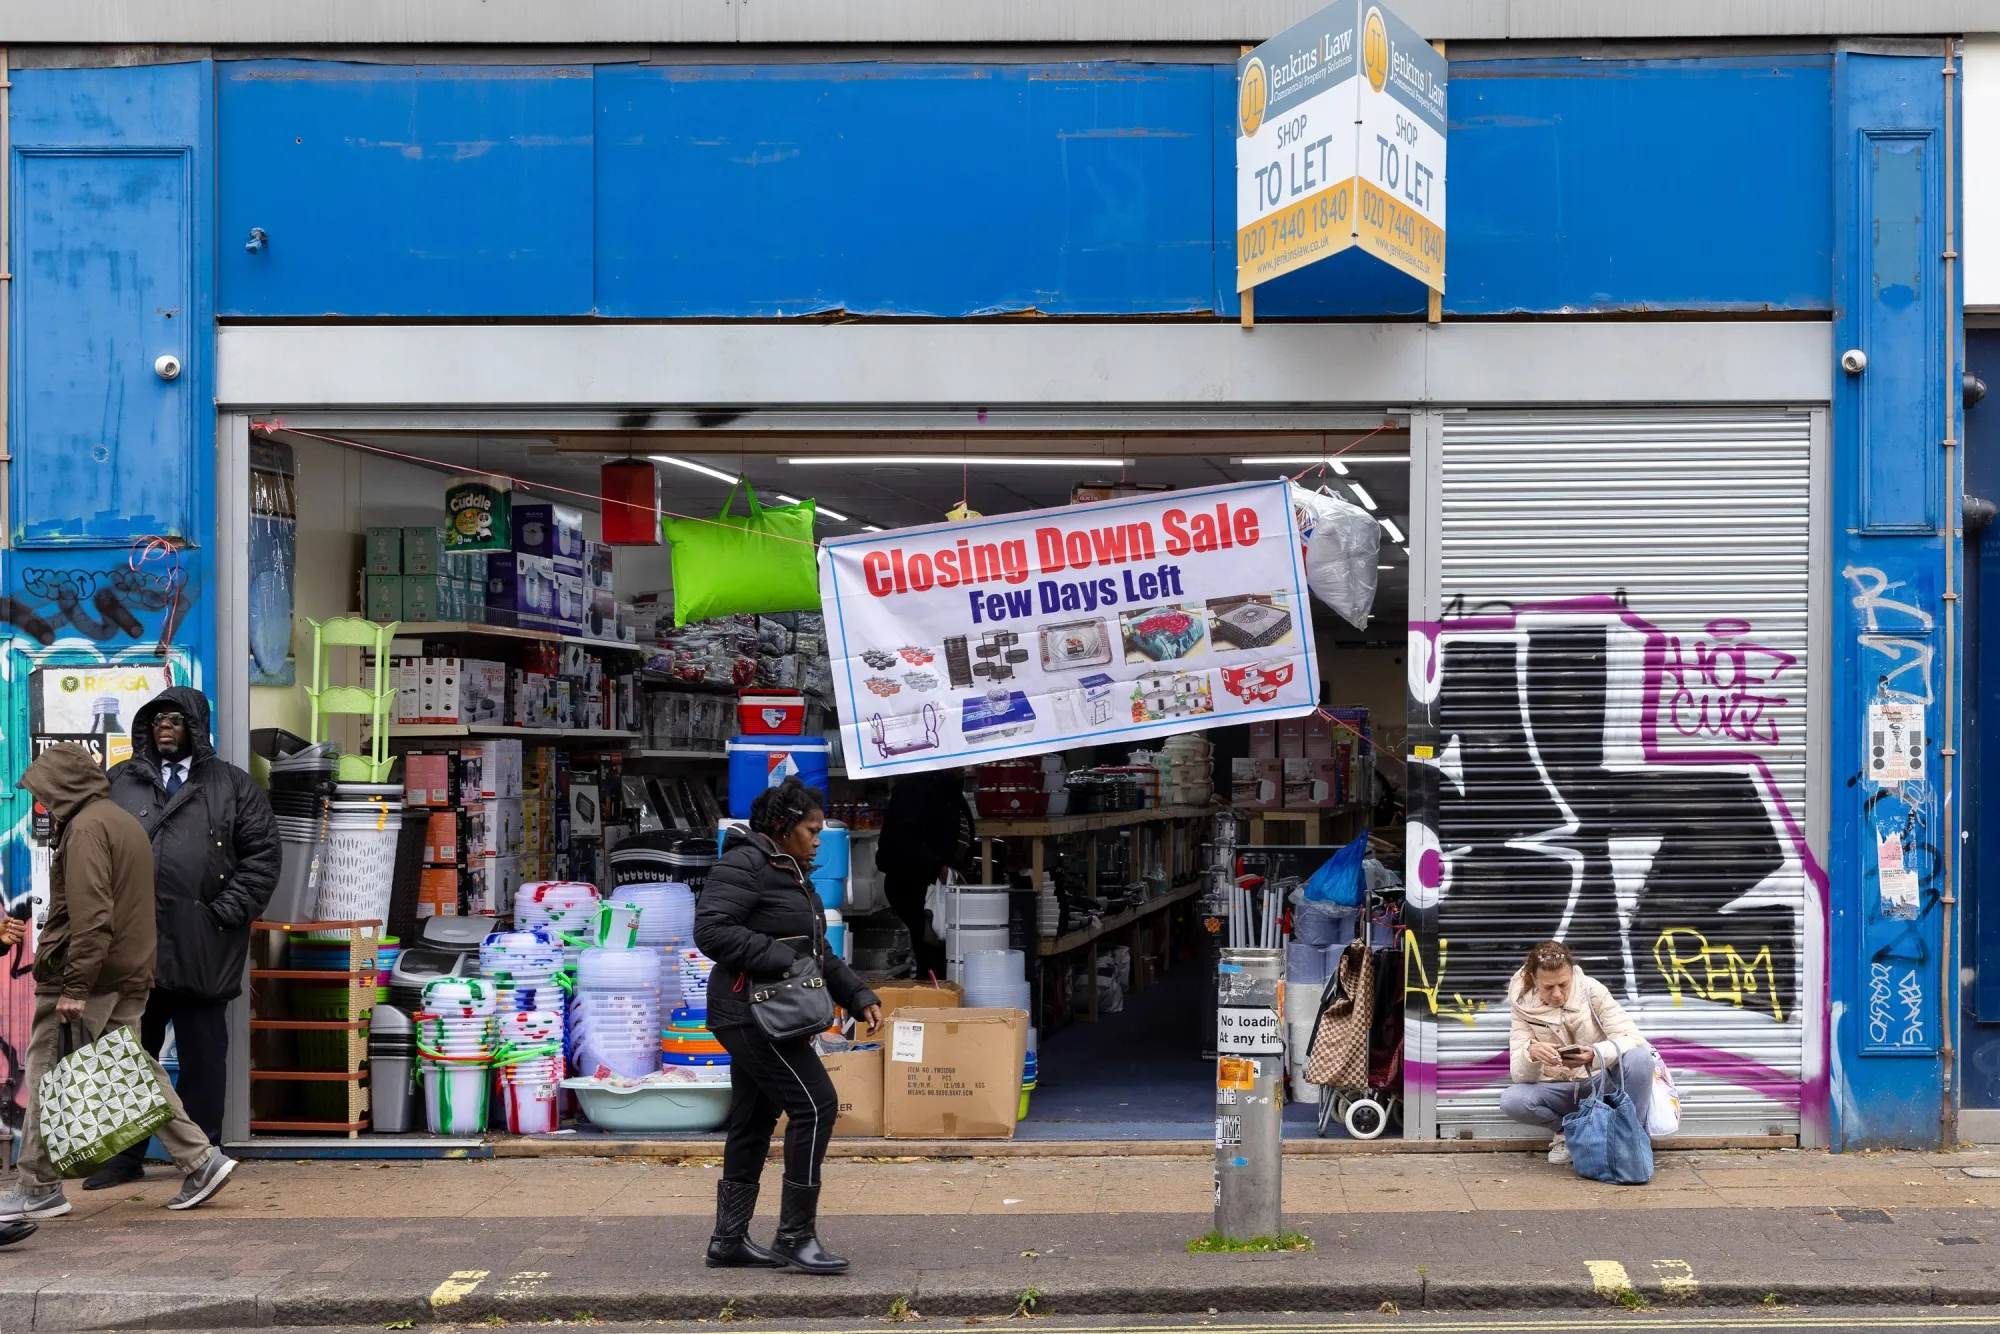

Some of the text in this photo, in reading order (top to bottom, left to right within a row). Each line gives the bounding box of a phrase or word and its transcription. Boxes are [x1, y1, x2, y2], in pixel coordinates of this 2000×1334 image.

[1269, 28, 1353, 105] Jenkins Law
[1274, 53, 1353, 102] Commercial Property Solutions
[1390, 40, 1445, 109] Jenkins Law
[1277, 114, 1308, 150] SHOP
[1395, 113, 1418, 148] SHOP
[1255, 134, 1332, 212] TO LET
[1376, 134, 1434, 212] TO LET
[1243, 188, 1347, 263] 020 7440 1840
[1363, 188, 1441, 264] 020 7440 1840
[1257, 233, 1329, 274] www.jenkinslaw.co.uk
[1375, 236, 1430, 275] www.jenkinslaw.co.uk
[450, 493, 492, 512] Cuddle
[457, 534, 463, 545] 9
[862, 502, 1260, 598] Closing Down Sale
[969, 563, 1184, 624] Few Days Left
[1653, 927, 1783, 1022] REM
[1219, 1031, 1229, 1043] At
[1233, 1034, 1256, 1046] any
[1221, 1015, 1280, 1027] No loadin
[57, 1147, 98, 1172] habitat
